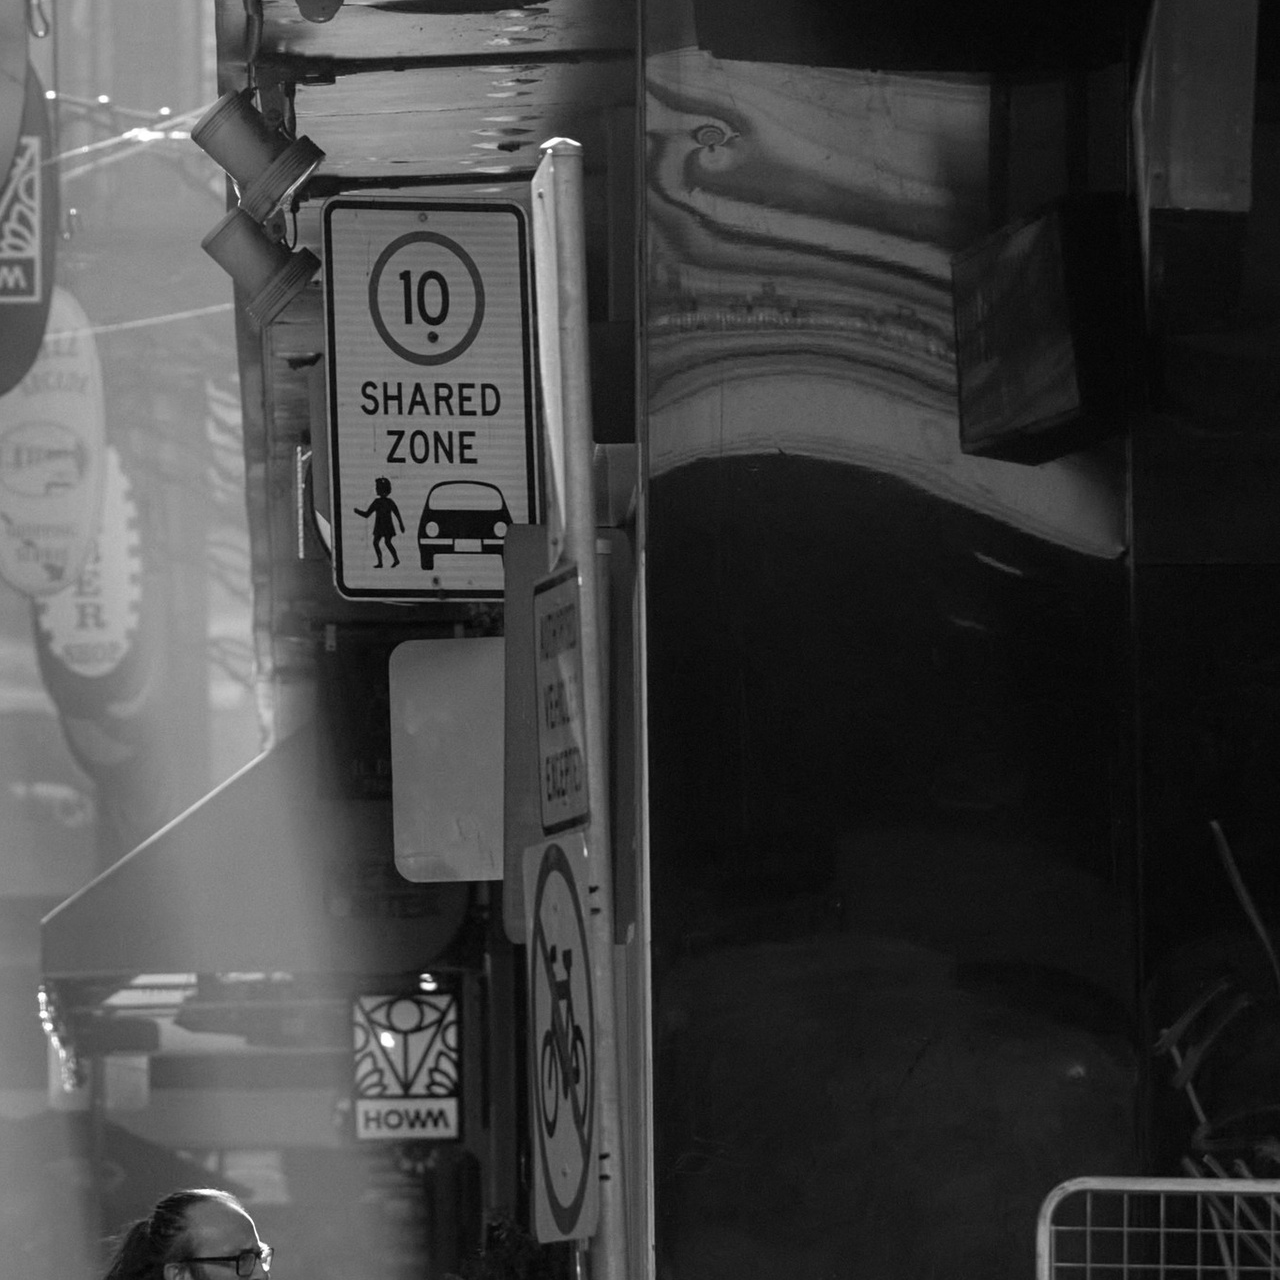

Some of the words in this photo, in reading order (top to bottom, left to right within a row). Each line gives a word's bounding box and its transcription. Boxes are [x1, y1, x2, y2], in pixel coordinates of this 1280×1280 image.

[398, 269, 451, 327] 10
[360, 380, 502, 417] SHARED
[385, 428, 479, 465] ZONE
